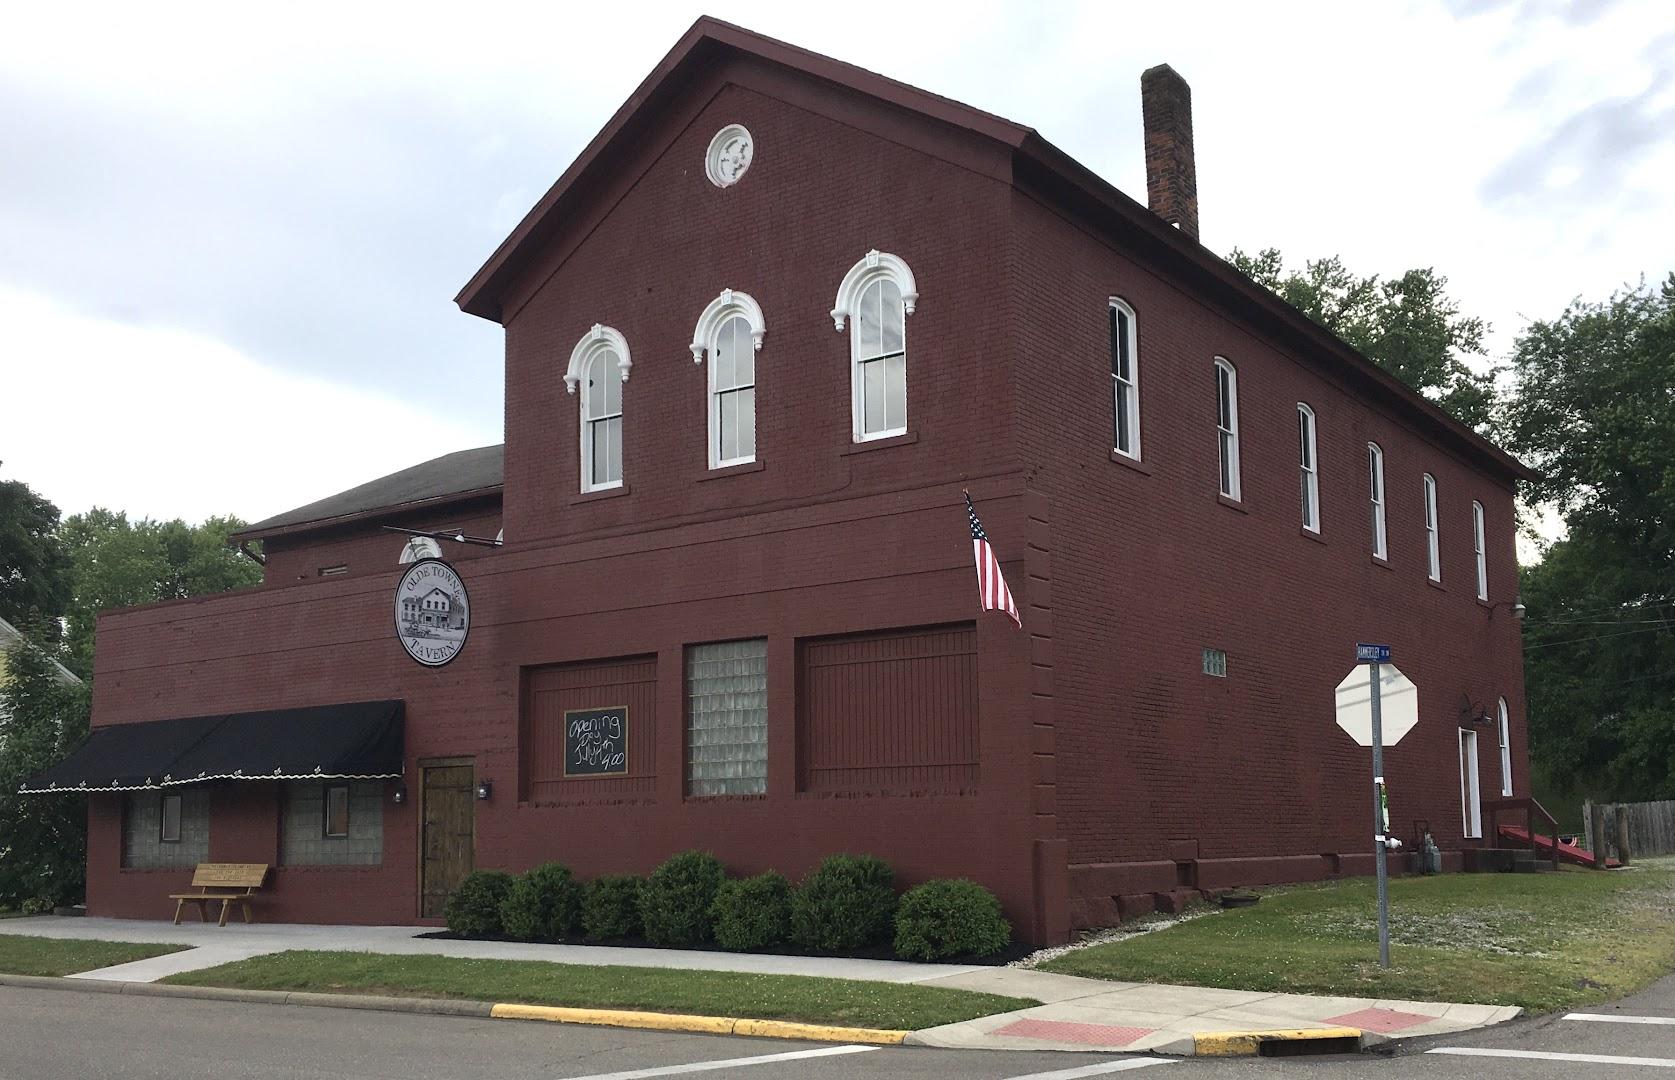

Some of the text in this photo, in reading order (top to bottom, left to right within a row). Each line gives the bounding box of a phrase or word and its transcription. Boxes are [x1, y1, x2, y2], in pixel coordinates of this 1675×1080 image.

[406, 566, 464, 601] OLDE TOWNE
[409, 638, 456, 660] TAVERN
